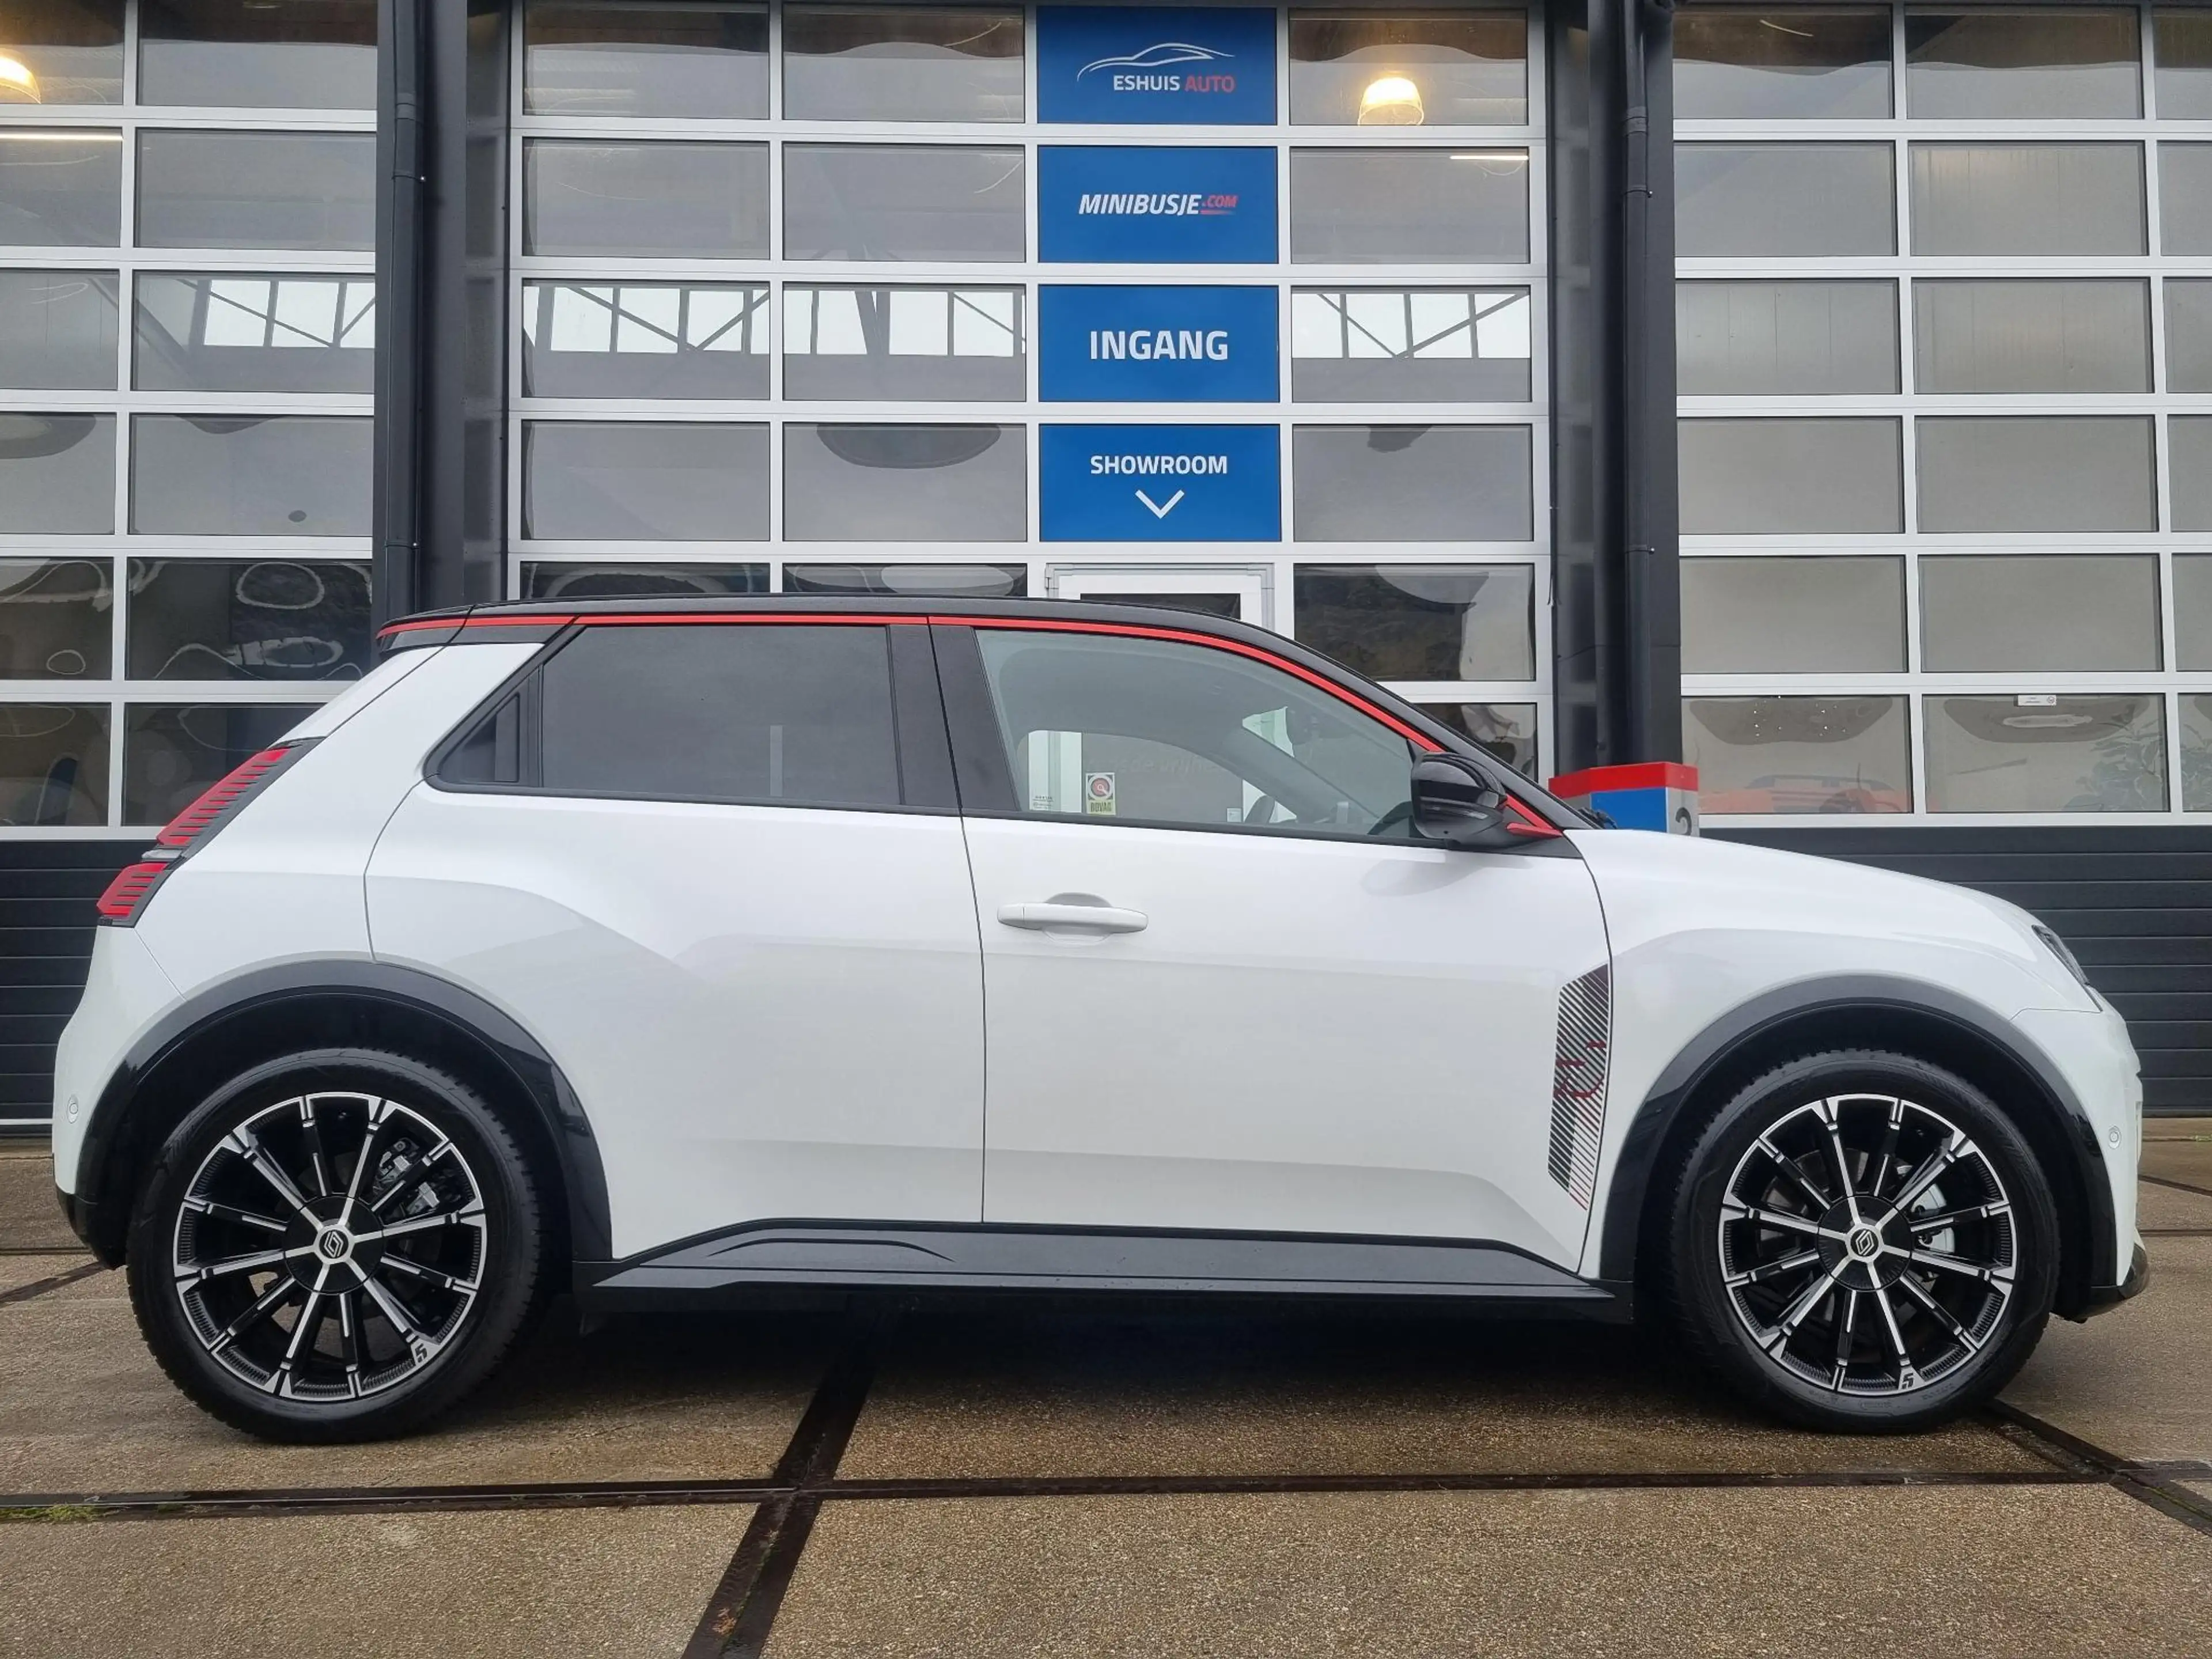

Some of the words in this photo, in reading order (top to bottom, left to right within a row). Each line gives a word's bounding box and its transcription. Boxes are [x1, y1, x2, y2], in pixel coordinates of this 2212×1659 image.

[1113, 75, 1180, 91] ESHUIS
[1184, 75, 1236, 93] AUTO
[1090, 330, 1228, 360] INGANG
[1090, 456, 1228, 475] SHOWROOM
